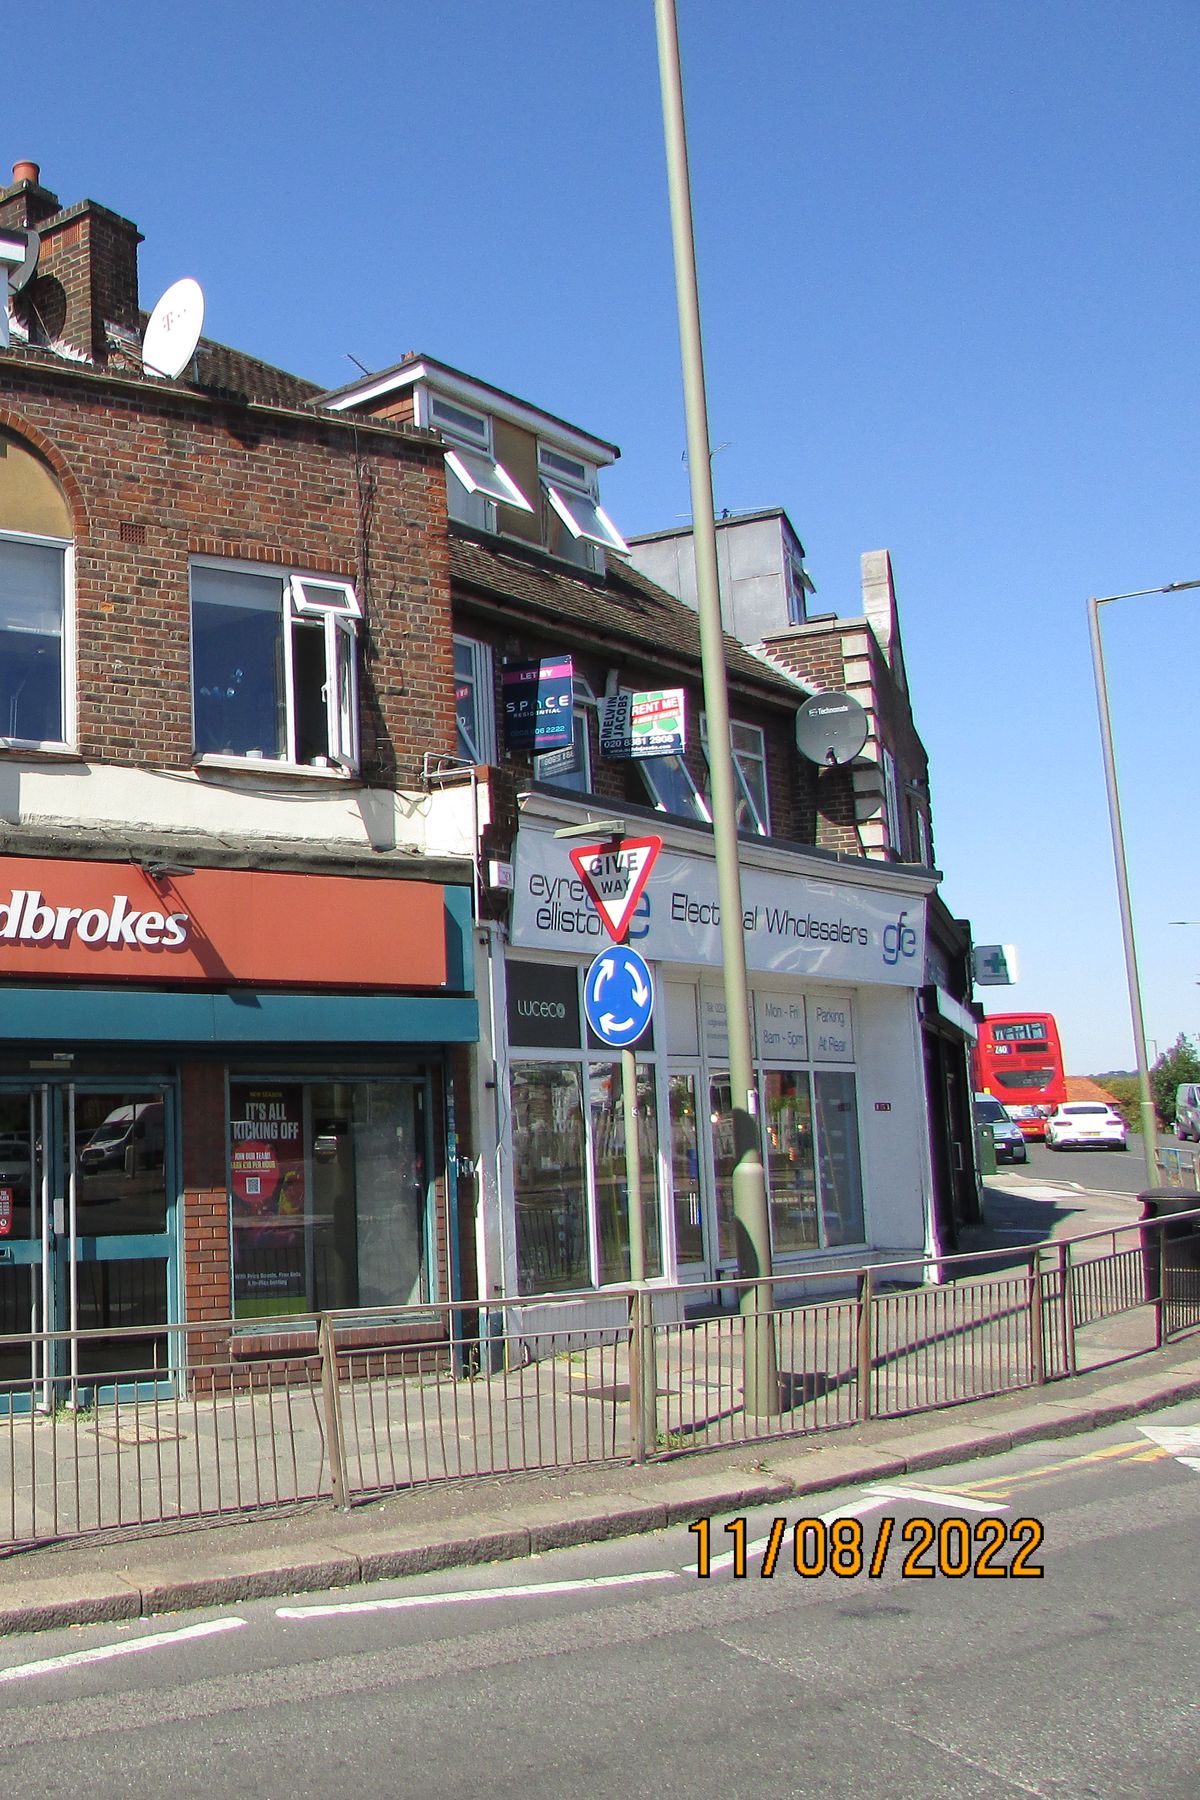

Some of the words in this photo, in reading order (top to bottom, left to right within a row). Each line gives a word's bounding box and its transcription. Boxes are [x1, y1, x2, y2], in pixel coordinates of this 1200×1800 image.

[520, 672, 537, 680] LET
[539, 669, 553, 678] BY
[632, 701, 660, 716] RENT
[662, 697, 678, 710] ME
[601, 696, 618, 739] MELVIN
[613, 695, 628, 738] JACOBS
[546, 725, 565, 734] 2222
[604, 740, 622, 748] 020
[590, 852, 638, 877] GIVE
[529, 873, 584, 903] eyre
[601, 878, 631, 894] WAY
[671, 892, 758, 931] Electal
[765, 906, 868, 946] Wholesalers
[882, 911, 916, 965] gfe
[765, 1003, 782, 1018] Mon
[789, 1004, 800, 1019] Fri
[816, 1007, 845, 1028] Parking
[763, 1029, 780, 1045] 8am
[787, 1031, 804, 1047] 5pm
[817, 1036, 827, 1051] At
[828, 1037, 846, 1052] Rear
[245, 1102, 266, 1121] IT'S
[269, 1103, 287, 1121] ALL
[233, 1122, 278, 1140] KICKING
[280, 1122, 299, 1140] OFF
